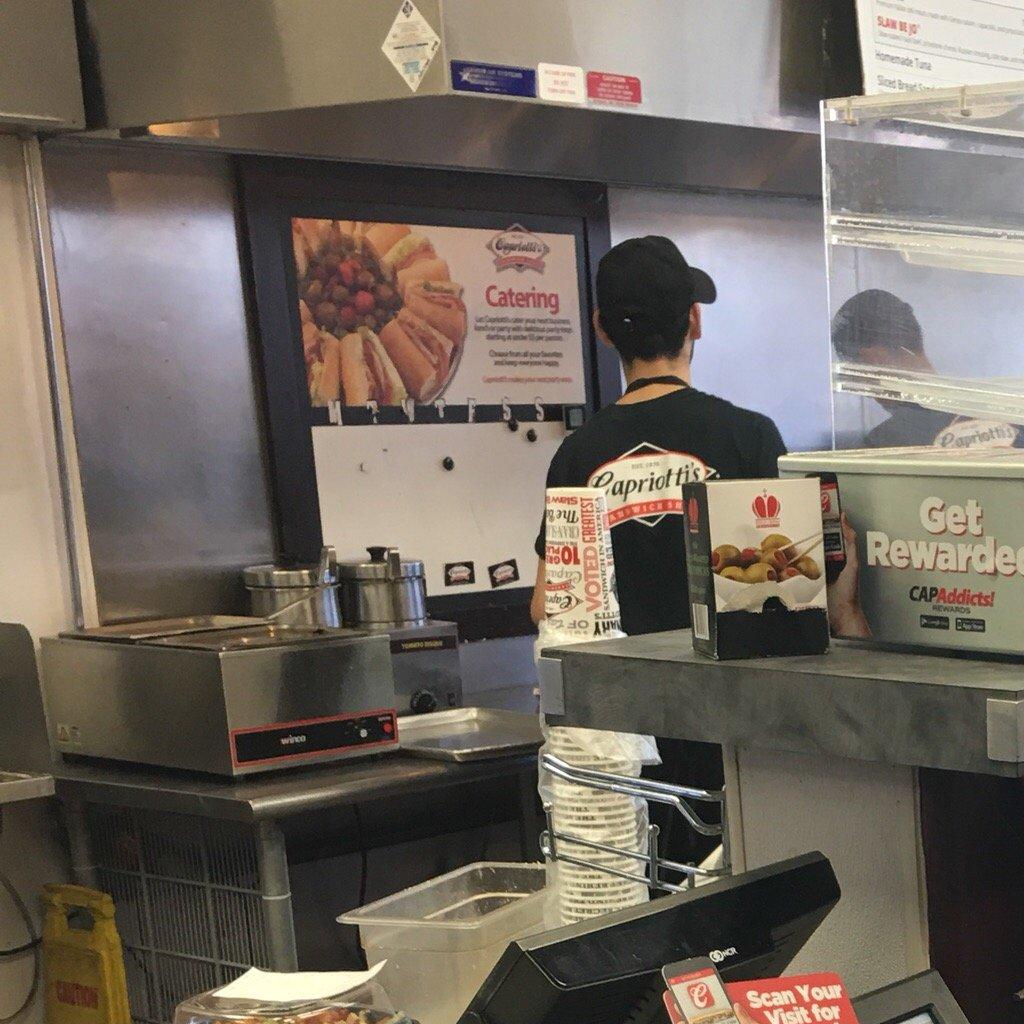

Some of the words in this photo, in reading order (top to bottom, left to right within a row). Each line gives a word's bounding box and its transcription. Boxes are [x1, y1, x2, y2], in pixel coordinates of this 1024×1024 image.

[874, 49, 914, 67] Homemade
[485, 285, 560, 315] Catering
[591, 461, 700, 502] Capriotti's
[557, 509, 579, 523] The
[580, 497, 597, 543] GREATEST
[919, 496, 984, 537] Get
[561, 545, 580, 565] 10
[582, 546, 602, 613] VOTED
[599, 556, 611, 611] SANDWICH
[909, 585, 996, 608] CAPAddicts!
[932, 604, 971, 614] REWARDS
[721, 946, 738, 958] NCR
[746, 988, 797, 1010] Scan
[795, 983, 843, 1002] Your
[811, 1004, 841, 1022] for
